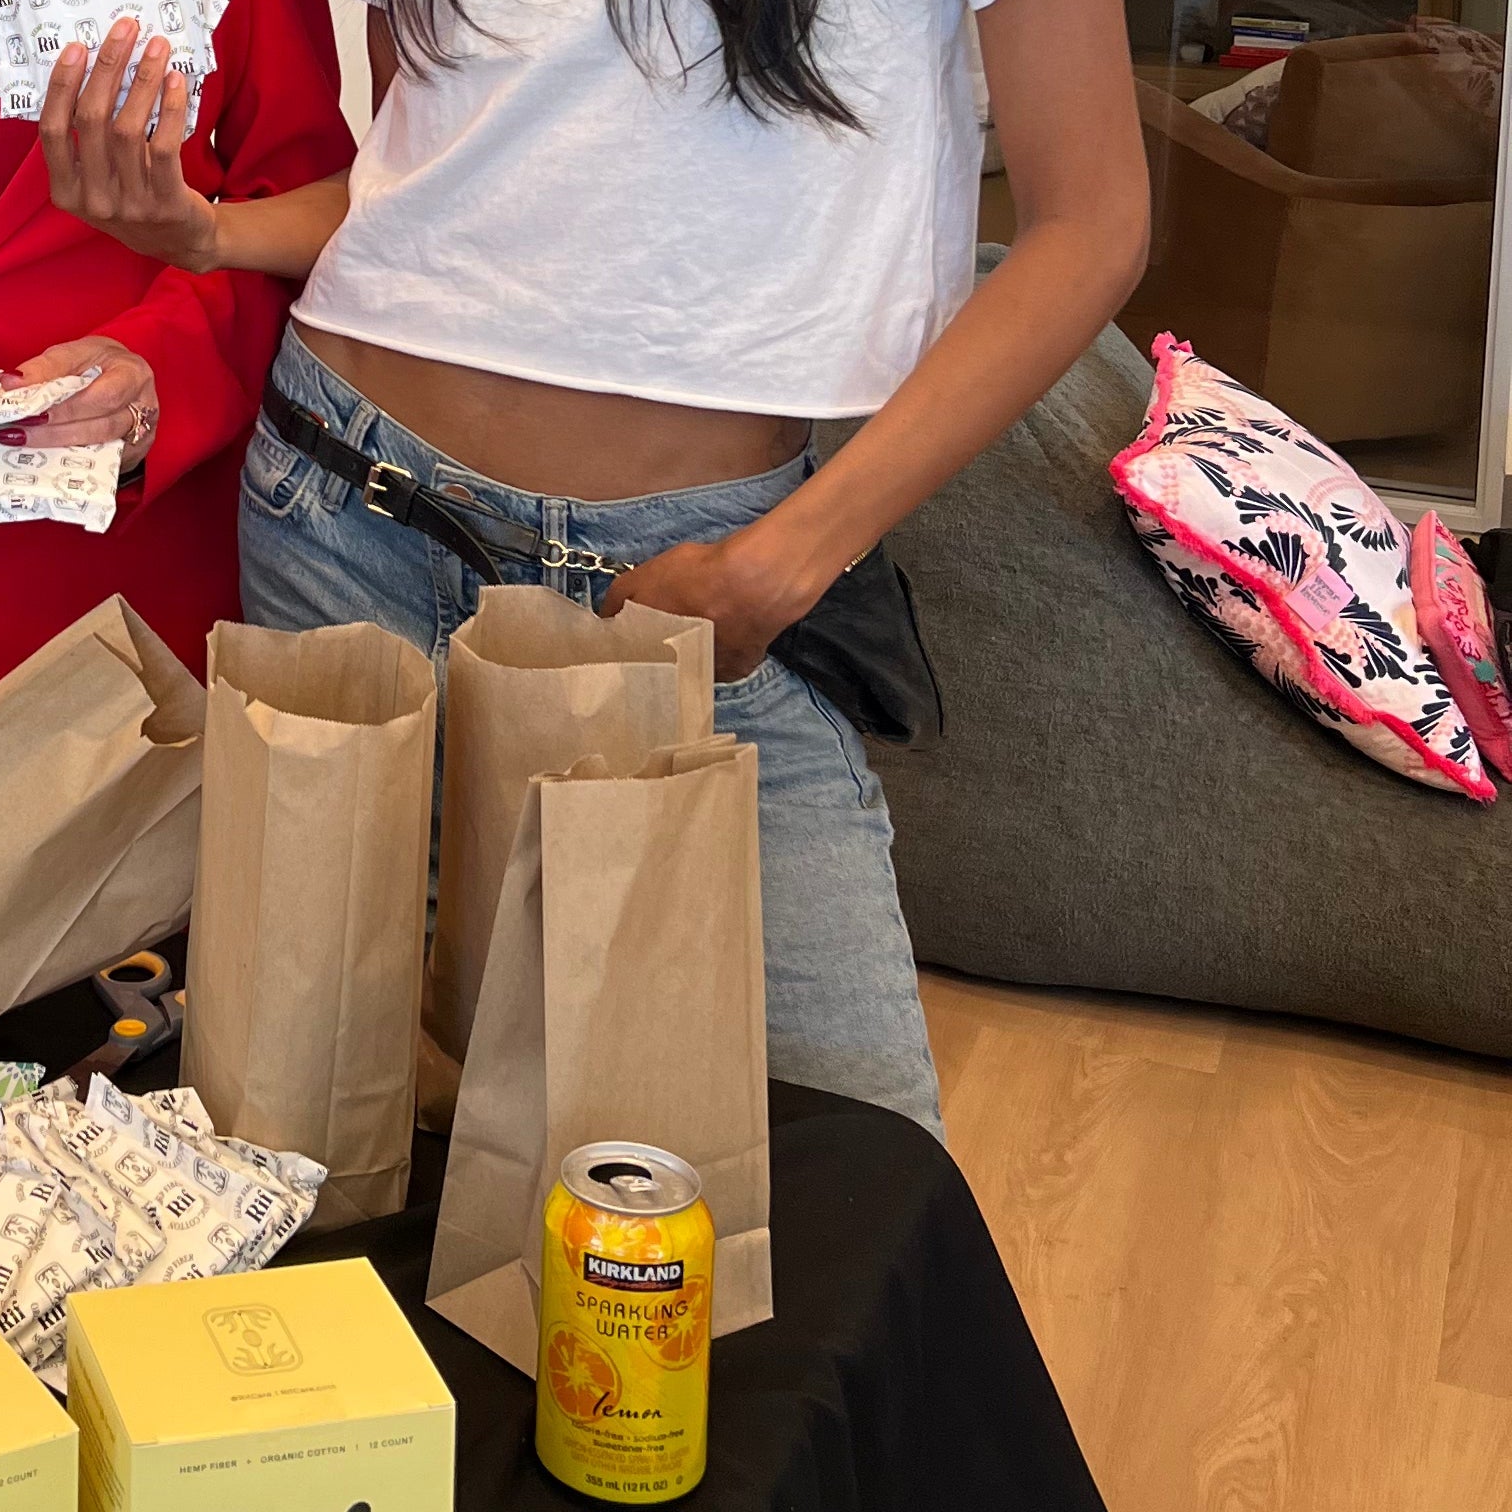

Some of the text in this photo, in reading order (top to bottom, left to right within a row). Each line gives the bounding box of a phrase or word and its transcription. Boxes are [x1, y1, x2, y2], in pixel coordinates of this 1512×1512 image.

[37, 33, 60, 53] Rif
[10, 92, 33, 110] Rif
[77, 1121, 105, 1146] Rif
[30, 1181, 54, 1203] Ri
[167, 1189, 196, 1218] Rif
[245, 1190, 274, 1224] Rif
[588, 1257, 681, 1281] KIRKLAND
[39, 1303, 66, 1331] Rif
[575, 1290, 688, 1321] SPARKLING
[596, 1319, 668, 1340] WATER
[592, 1392, 663, 1419] lemon
[179, 1464, 207, 1474] HEMP
[210, 1460, 237, 1471] FIBER
[260, 1451, 304, 1464] ORGANIC
[307, 1445, 346, 1457] COTTON
[369, 1441, 378, 1449] 12
[381, 1435, 414, 1448] COUNT
[6, 1469, 38, 1485] COUNT
[585, 1473, 603, 1487] 355
[605, 1480, 620, 1491] mL
[622, 1482, 638, 1492] (12
[639, 1483, 651, 1492] FL
